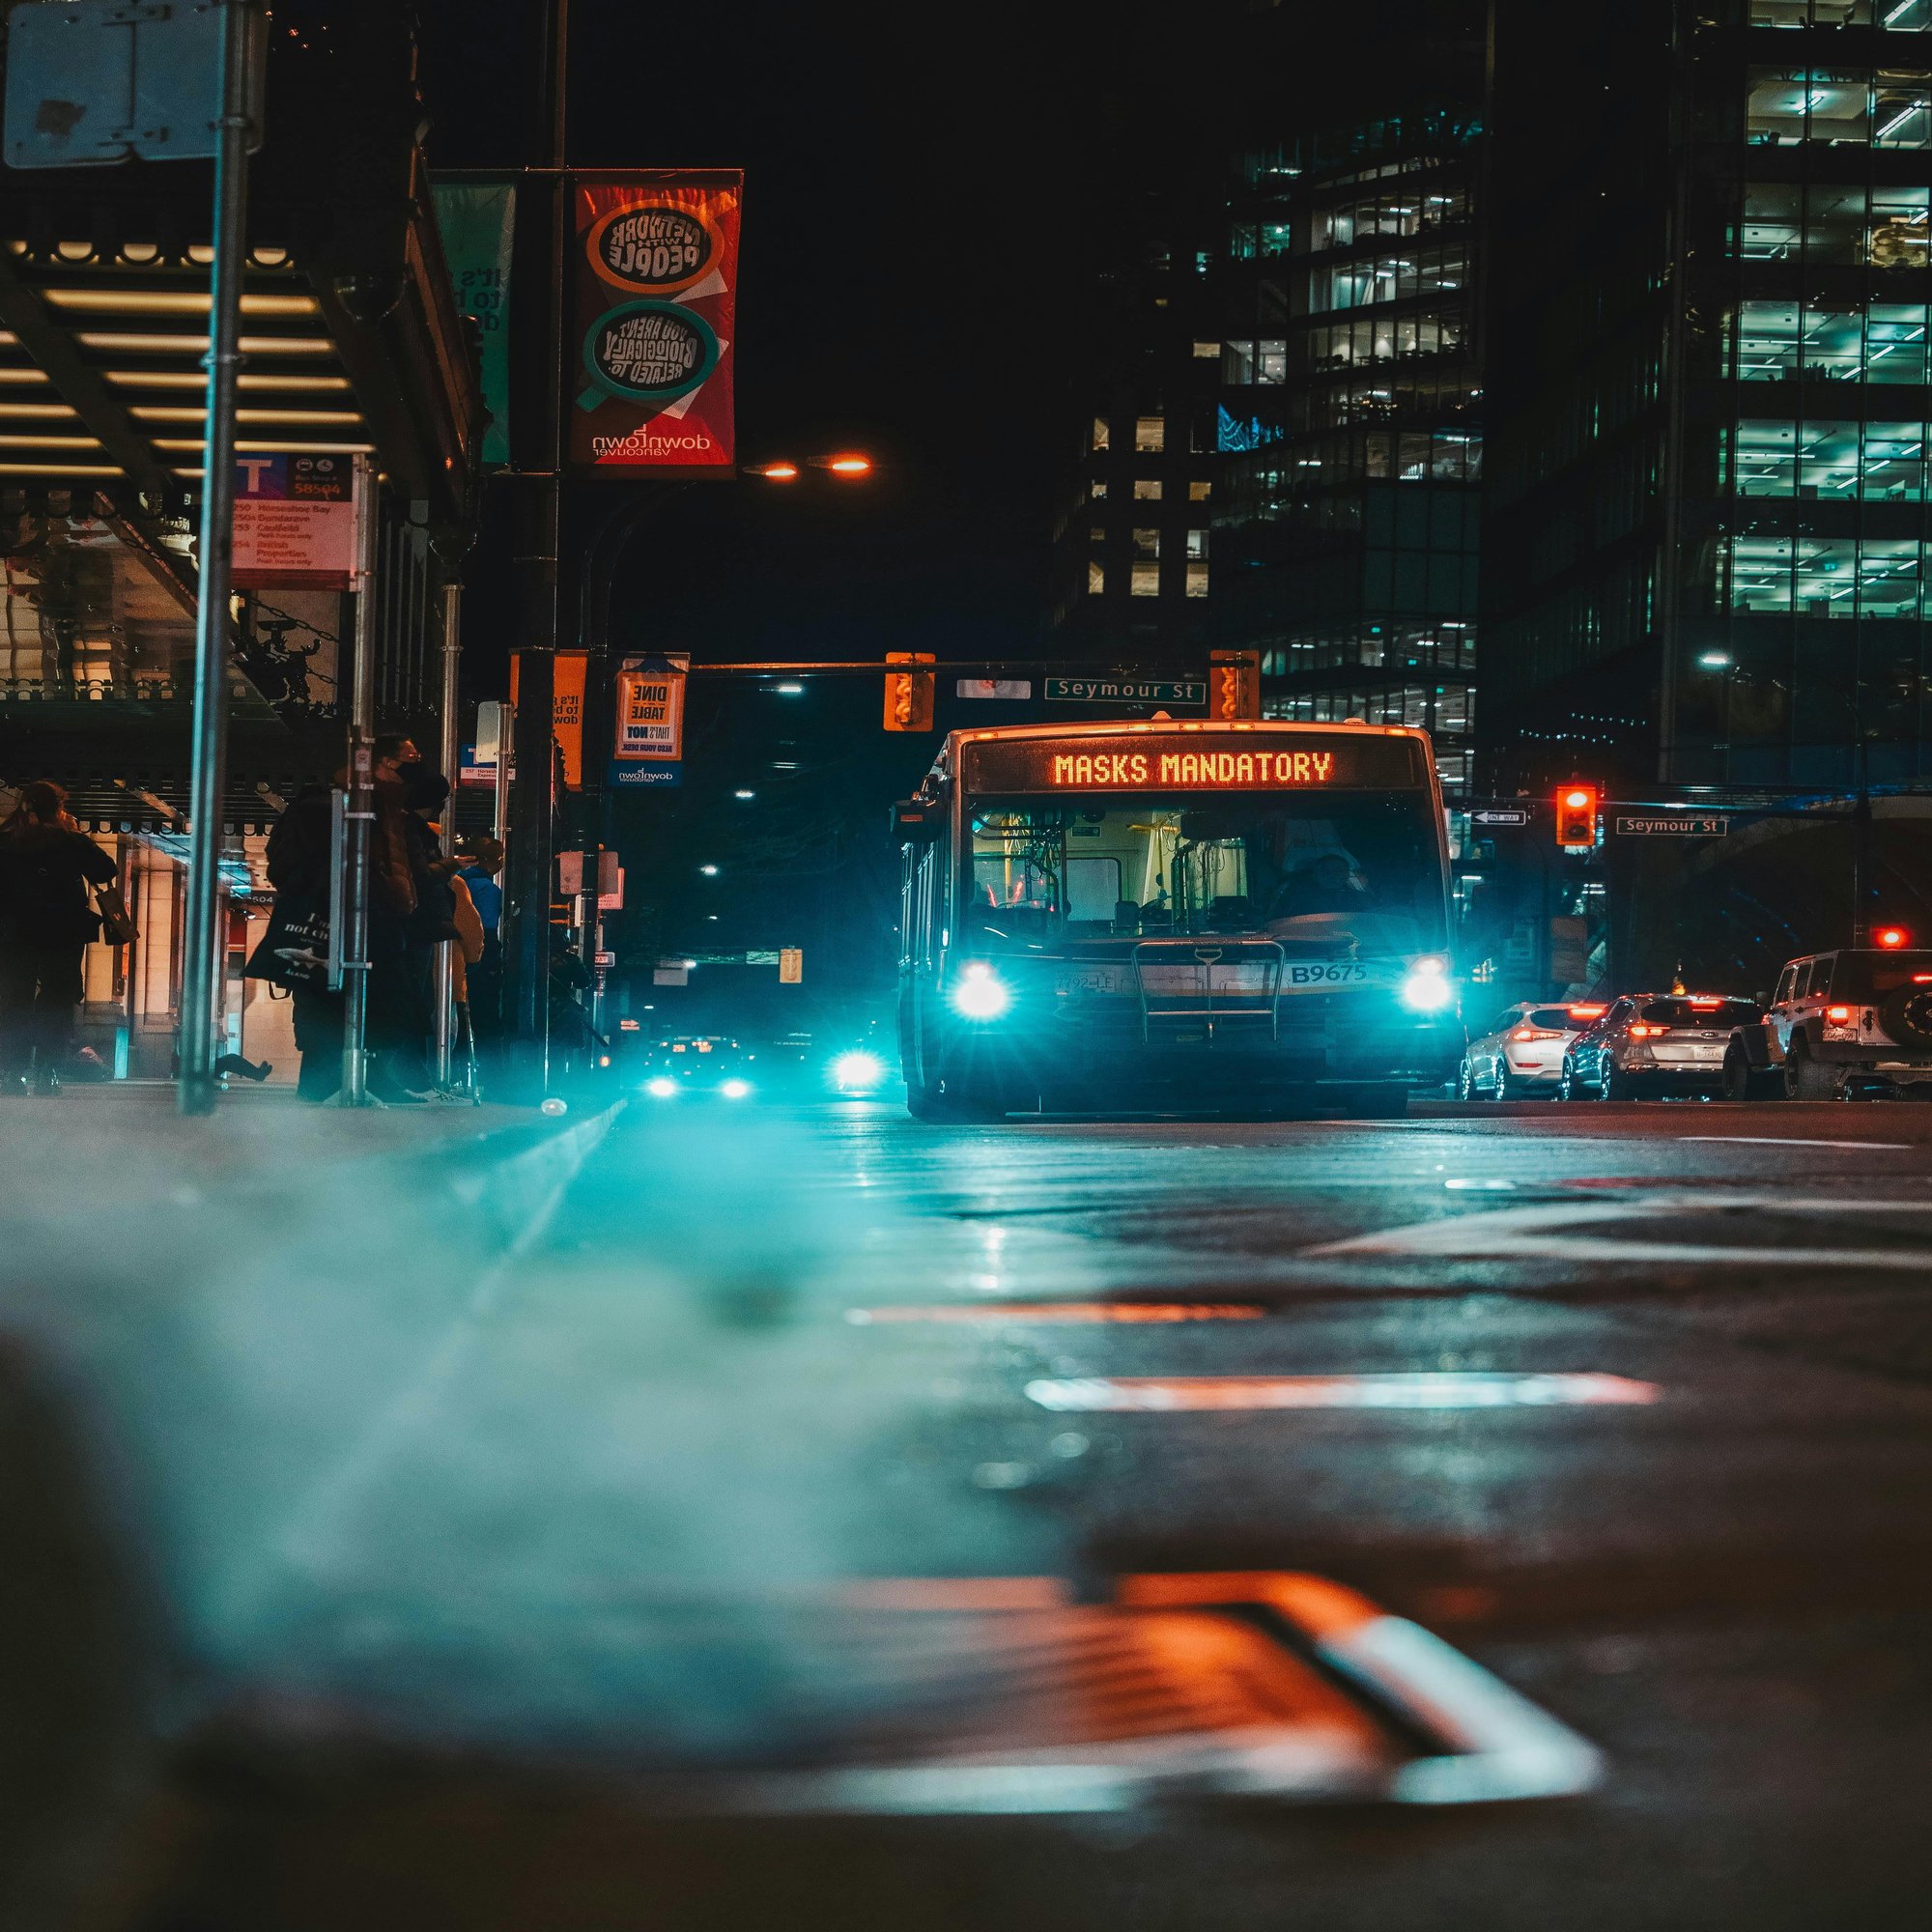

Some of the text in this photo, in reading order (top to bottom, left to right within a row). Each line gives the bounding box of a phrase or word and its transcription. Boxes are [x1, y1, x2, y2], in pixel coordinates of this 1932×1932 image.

[236, 459, 273, 493] T
[313, 505, 331, 515] Bay
[1058, 680, 1193, 698] Seymour St
[1055, 753, 1331, 783] MASKS MANDATORY
[1626, 819, 1718, 834] Seymour St
[285, 923, 309, 935] not
[1292, 965, 1367, 983] B9675
